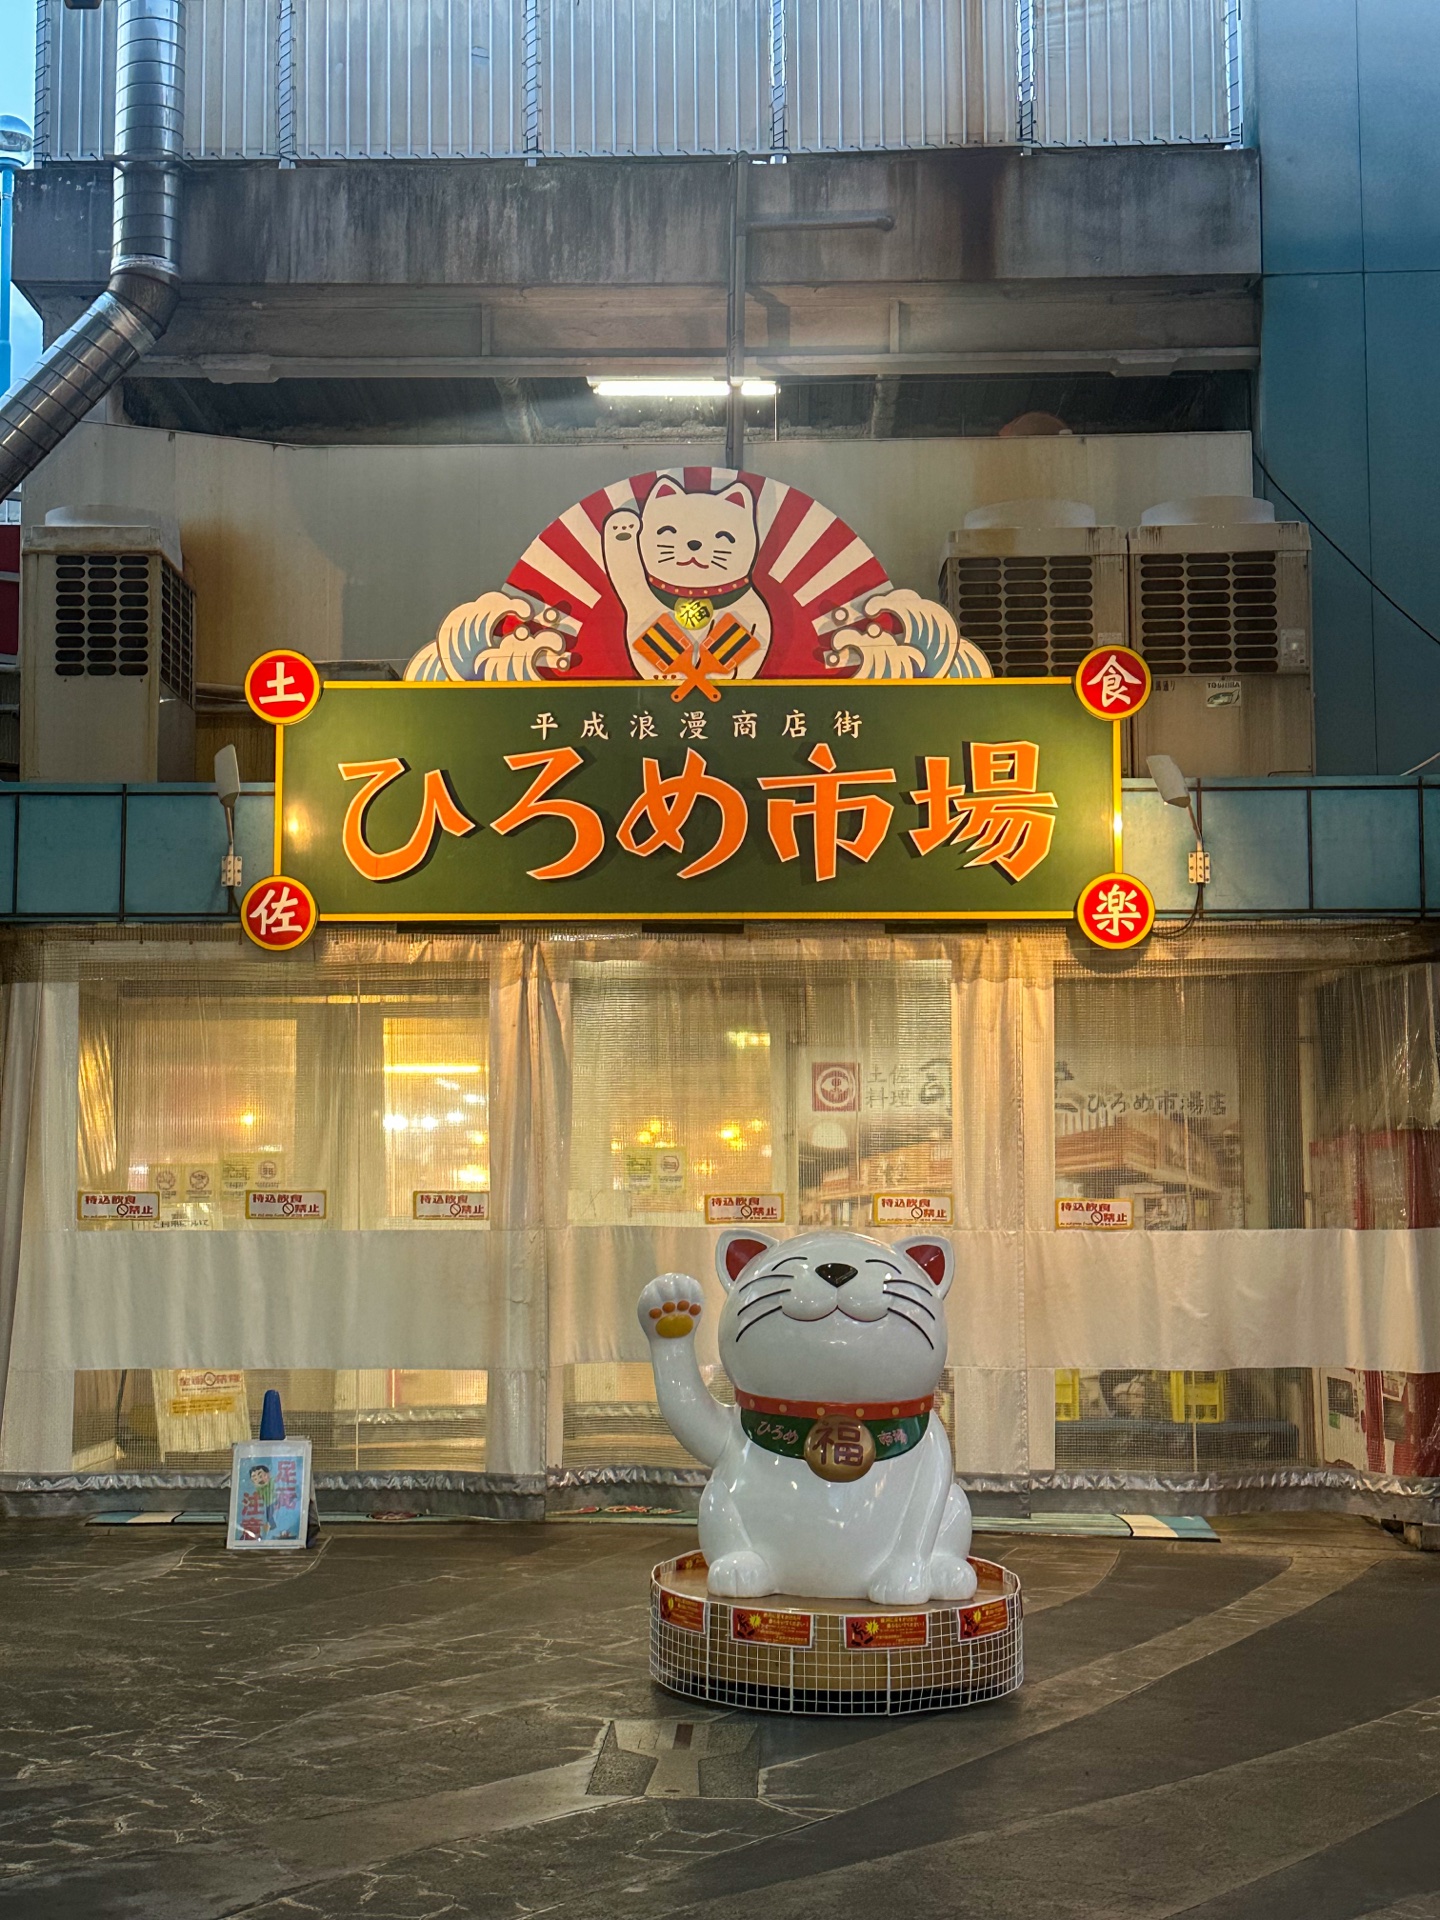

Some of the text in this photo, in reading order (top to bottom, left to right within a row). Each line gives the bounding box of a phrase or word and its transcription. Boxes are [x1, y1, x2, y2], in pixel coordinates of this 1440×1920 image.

[258, 661, 306, 705] 土
[1086, 654, 1142, 708] 食
[530, 709, 863, 741] 平成浪漫商店街
[337, 741, 1058, 882] ひろめ市場
[249, 886, 303, 936] 佐
[1091, 883, 1142, 937] 楽
[755, 1421, 799, 1445] ひろめ
[812, 1421, 864, 1467] 福
[274, 1460, 297, 1511] 足元
